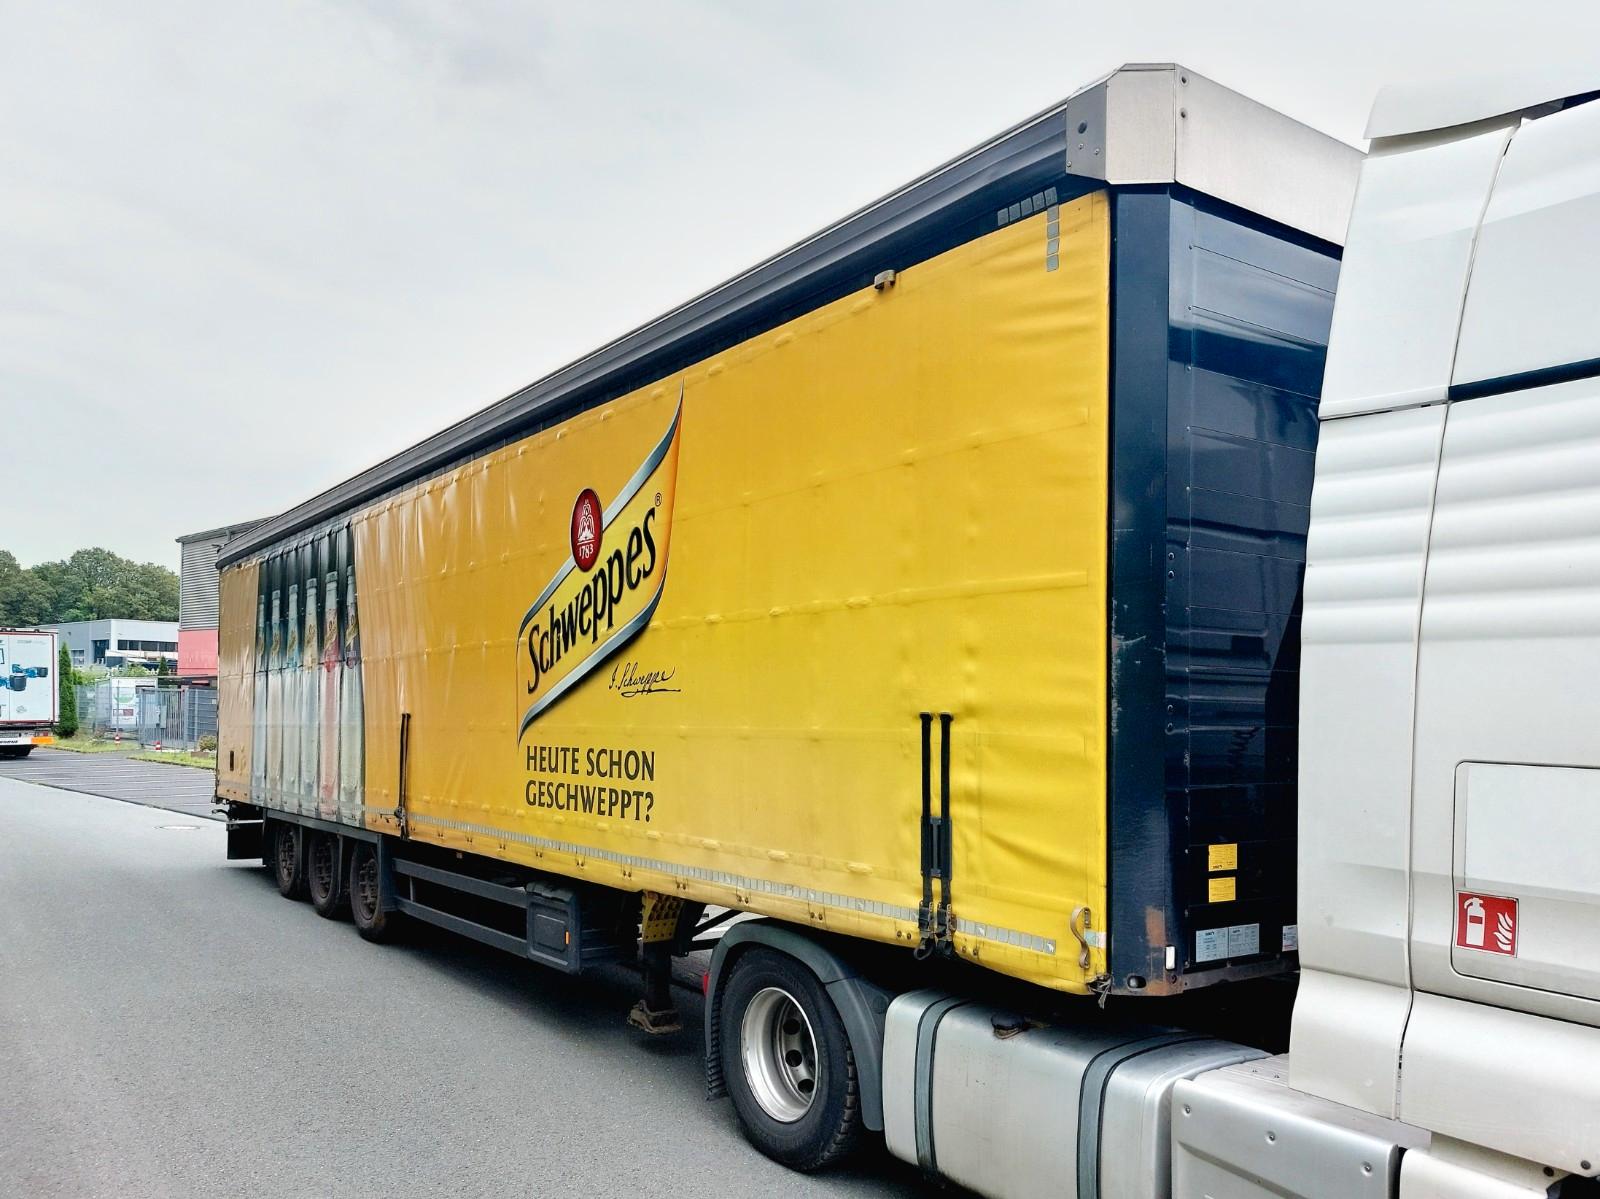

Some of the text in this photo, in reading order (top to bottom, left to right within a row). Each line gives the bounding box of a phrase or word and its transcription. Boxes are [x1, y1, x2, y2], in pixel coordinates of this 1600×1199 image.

[579, 543, 594, 559] 1783
[527, 507, 657, 694] Schweppes
[526, 745, 655, 782] HEUTE SCHON
[525, 779, 655, 822] GESCHWEPPT?
